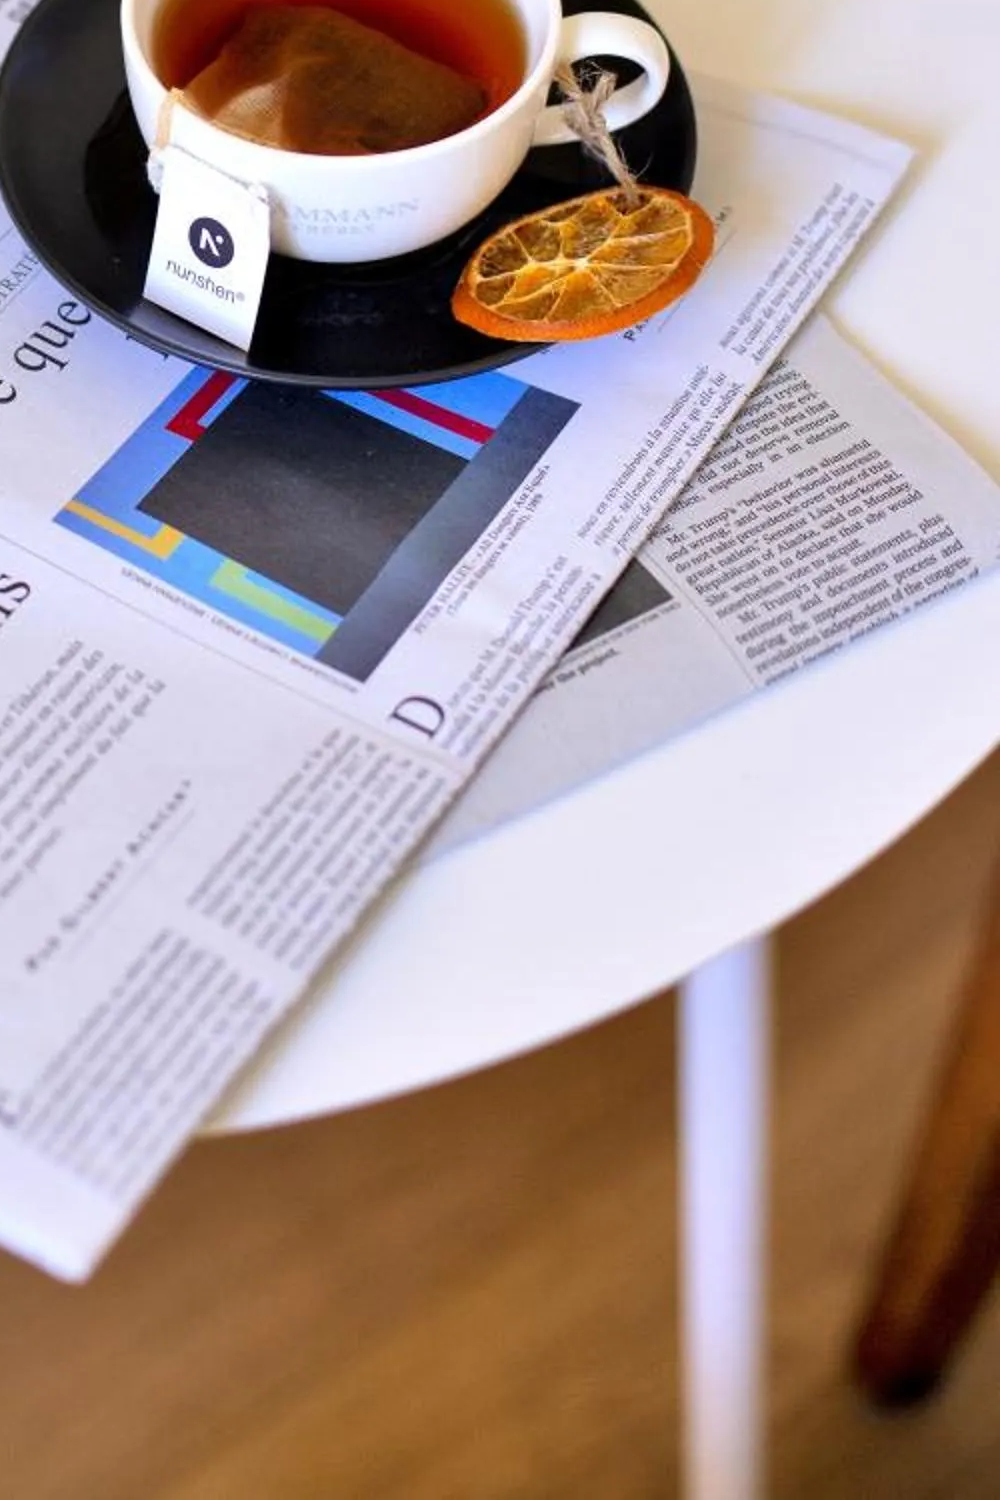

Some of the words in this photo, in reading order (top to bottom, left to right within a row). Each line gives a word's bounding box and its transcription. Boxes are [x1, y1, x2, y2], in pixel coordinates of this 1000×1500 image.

[13, 299, 93, 373] que
[695, 470, 717, 483] did
[720, 458, 741, 472] not
[744, 433, 791, 460] deserve
[793, 410, 840, 436] removal
[734, 410, 777, 435] dispute
[776, 400, 798, 414] the
[744, 434, 762, 445] on
[760, 424, 782, 438] the
[780, 412, 807, 428] idea
[806, 401, 829, 415] that
[664, 530, 688, 545] Mr.
[794, 466, 820, 482] was
[818, 440, 872, 470] shameful
[705, 461, 766, 494] especially
[768, 452, 784, 464] in
[785, 443, 803, 456] an
[804, 419, 852, 447] election
[662, 546, 689, 563] and
[734, 512, 759, 528] and
[782, 476, 834, 505] personal
[671, 559, 691, 573] do
[688, 550, 711, 565] not
[708, 537, 737, 555] take
[734, 506, 802, 543] precedence
[799, 492, 830, 511] over
[827, 477, 861, 498] those
[868, 461, 895, 478] this
[683, 563, 717, 584] great
[762, 518, 809, 545] Senator
[809, 504, 839, 522] Lisa
[692, 557, 761, 594] Republican
[758, 550, 775, 562] of
[774, 528, 821, 554] Alaska,
[819, 514, 849, 533] said
[846, 506, 866, 519] on
[728, 573, 760, 593] went
[758, 564, 779, 578] on
[777, 557, 794, 569] to
[792, 534, 841, 562] declare
[838, 522, 866, 539] that
[865, 510, 889, 526] she
[887, 493, 926, 515] would
[809, 563, 850, 587] public
[847, 530, 919, 569] statements,
[918, 515, 948, 535] plus
[783, 565, 813, 583] vote
[810, 558, 827, 570] to
[785, 619, 811, 636] the
[809, 579, 893, 625] impeachment
[891, 555, 942, 585] process
[939, 542, 970, 561] and
[795, 594, 825, 612] and
[824, 562, 890, 598] documents
[892, 529, 959, 566] introduced
[818, 598, 891, 638] independent
[889, 591, 907, 604] of
[902, 581, 926, 597] the
